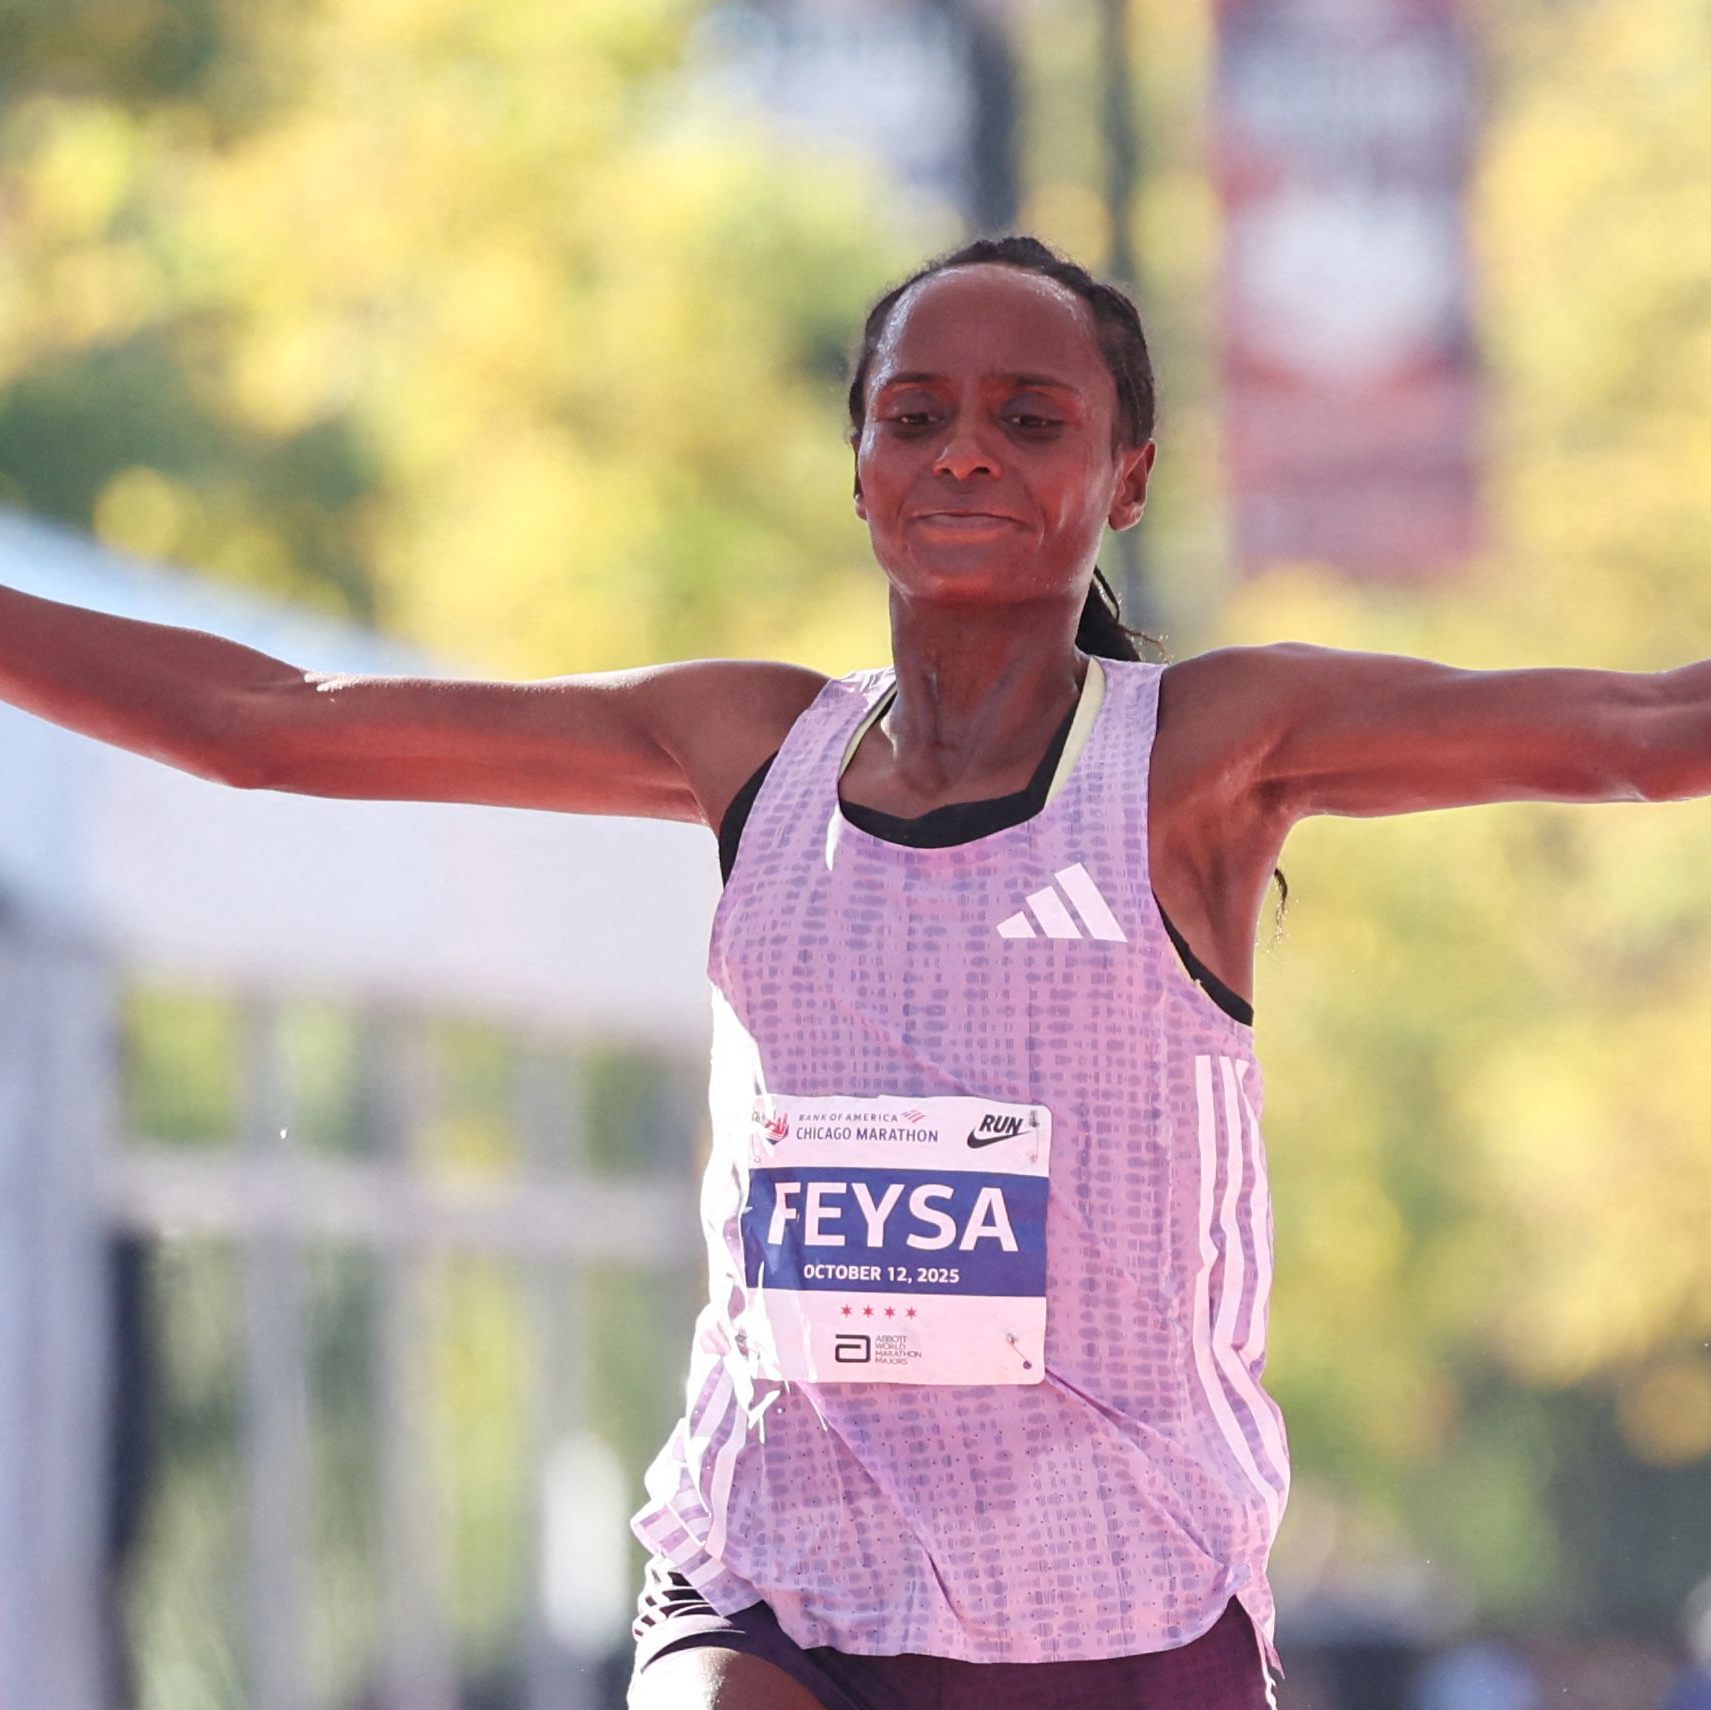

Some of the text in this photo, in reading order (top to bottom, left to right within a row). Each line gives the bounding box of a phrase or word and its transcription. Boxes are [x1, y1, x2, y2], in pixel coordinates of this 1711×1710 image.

[798, 1113, 898, 1123] BANK OF AMERICA
[979, 1114, 1024, 1136] RUN
[796, 1126, 939, 1143] CHICAGO MARATHON
[767, 1181, 1019, 1252] FEYSA
[803, 1263, 960, 1284] OCTOBER 12, 2025
[875, 1335, 907, 1343] ABBOTT
[875, 1350, 922, 1358] MARATHON
